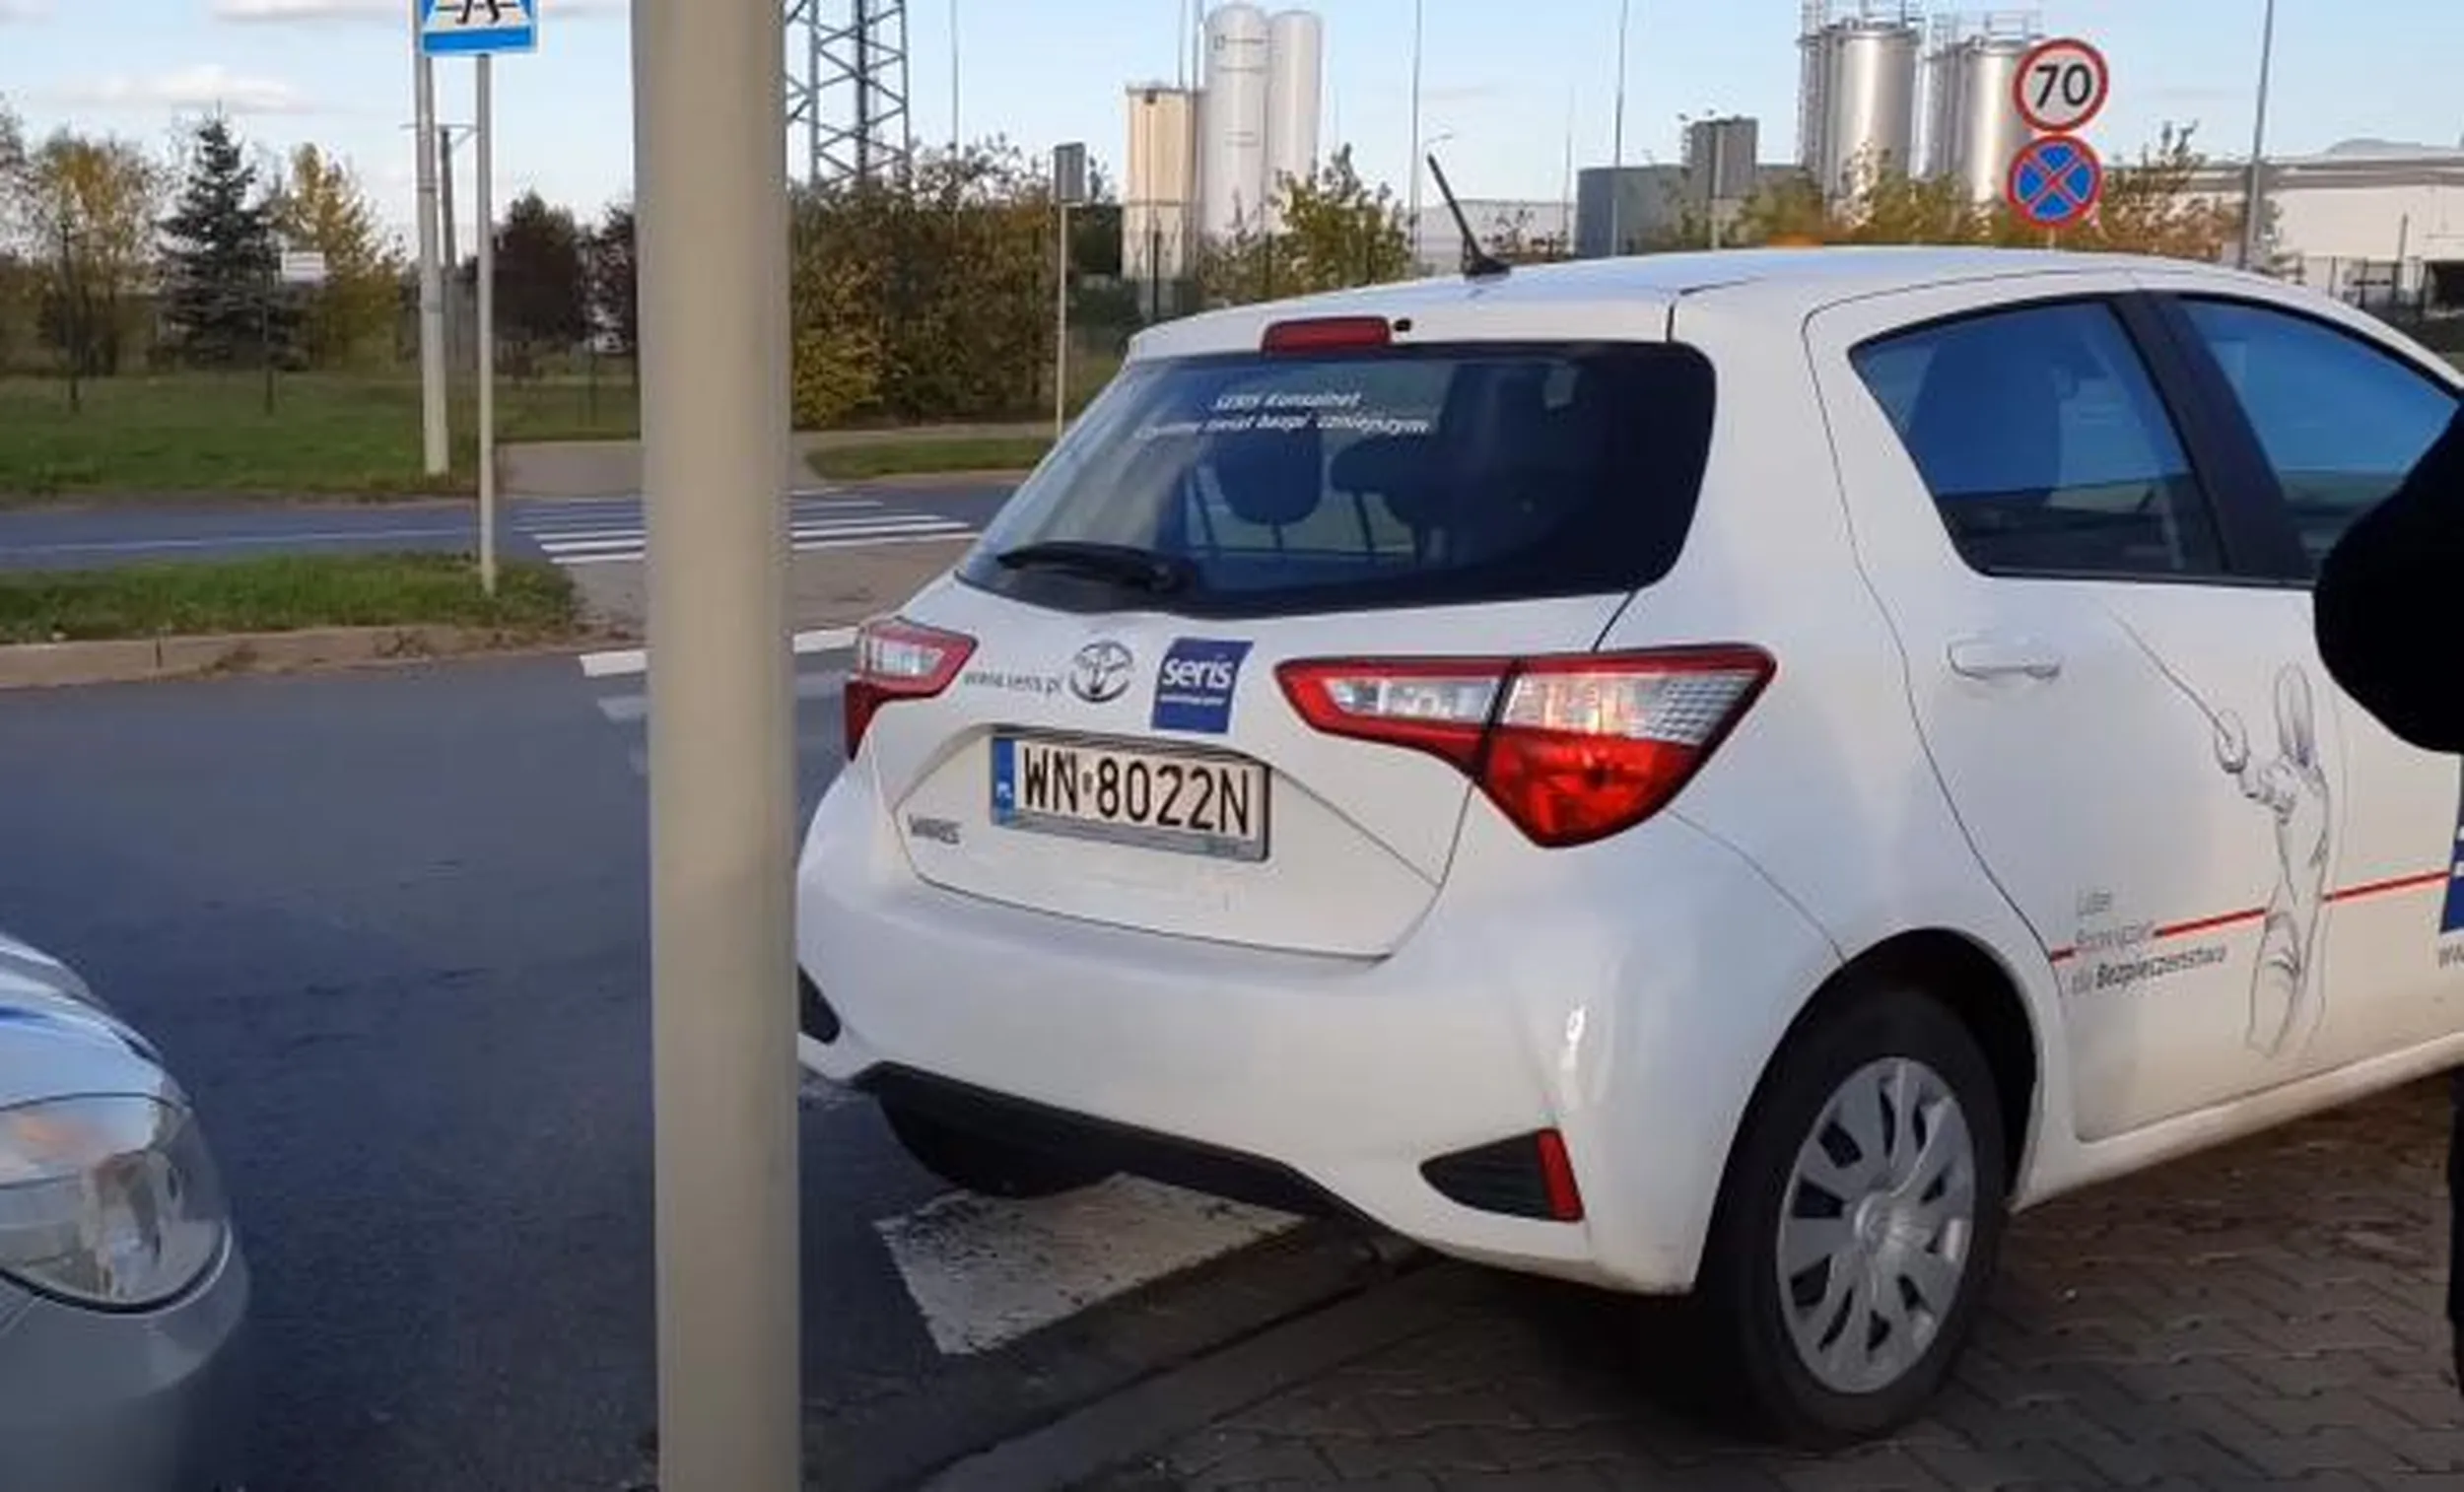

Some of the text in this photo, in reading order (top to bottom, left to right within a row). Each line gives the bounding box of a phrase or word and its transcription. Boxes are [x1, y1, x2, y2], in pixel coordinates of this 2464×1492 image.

[2035, 64, 2091, 108] 70
[1163, 656, 1232, 690] seris
[1024, 747, 1249, 836] WN 8022N
